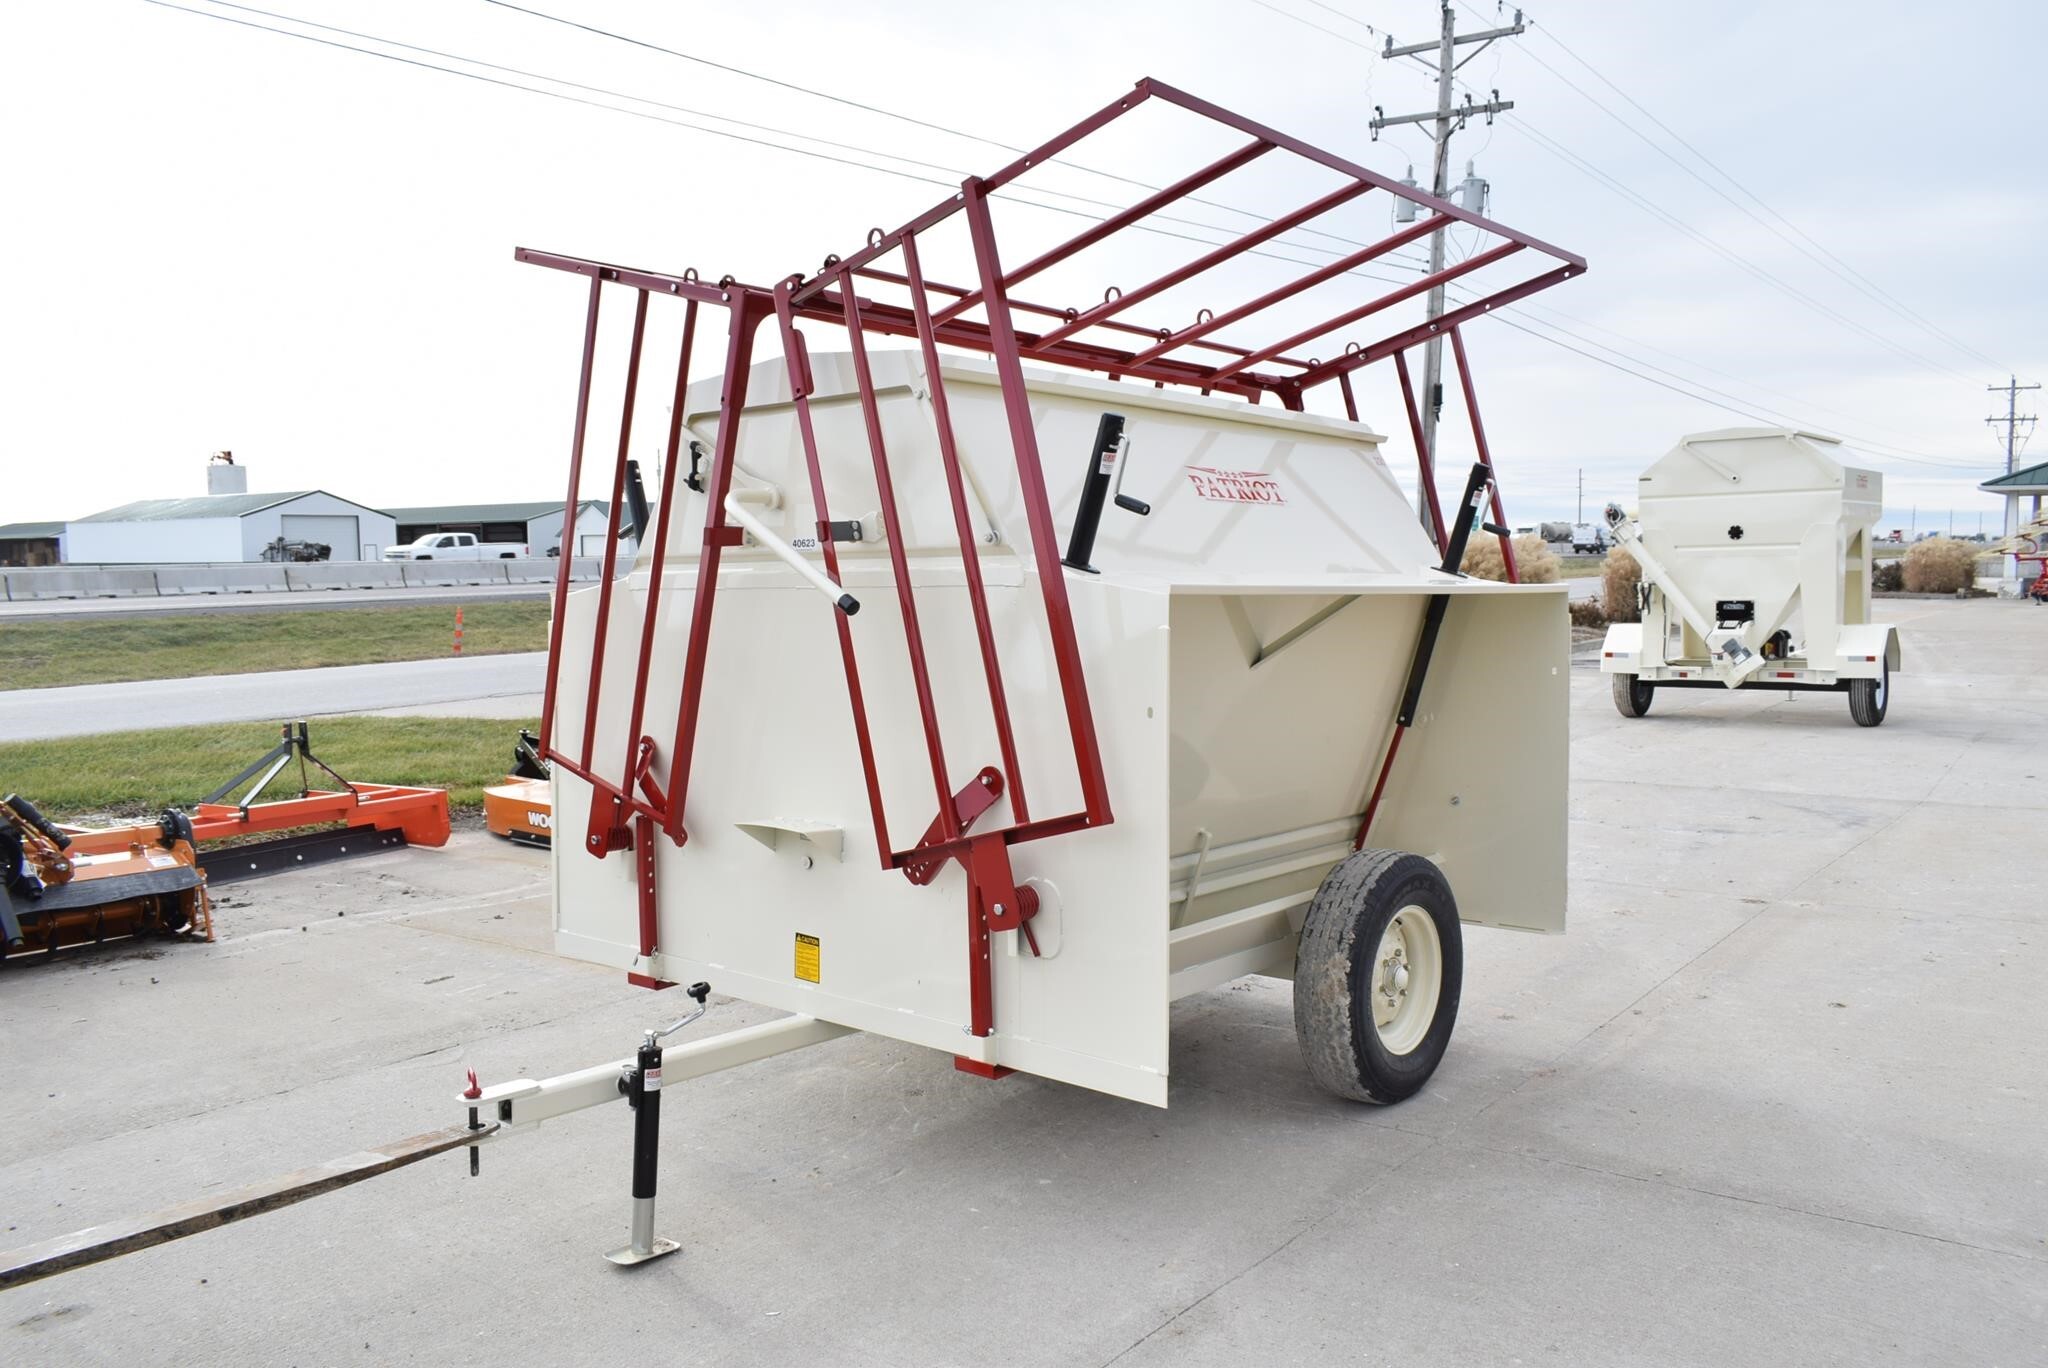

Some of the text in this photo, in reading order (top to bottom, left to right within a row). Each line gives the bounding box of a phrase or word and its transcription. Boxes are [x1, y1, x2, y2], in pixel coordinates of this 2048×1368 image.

[1188, 474, 1285, 503] PATRIOT
[792, 539, 816, 548] 40623
[527, 811, 552, 829] WO
